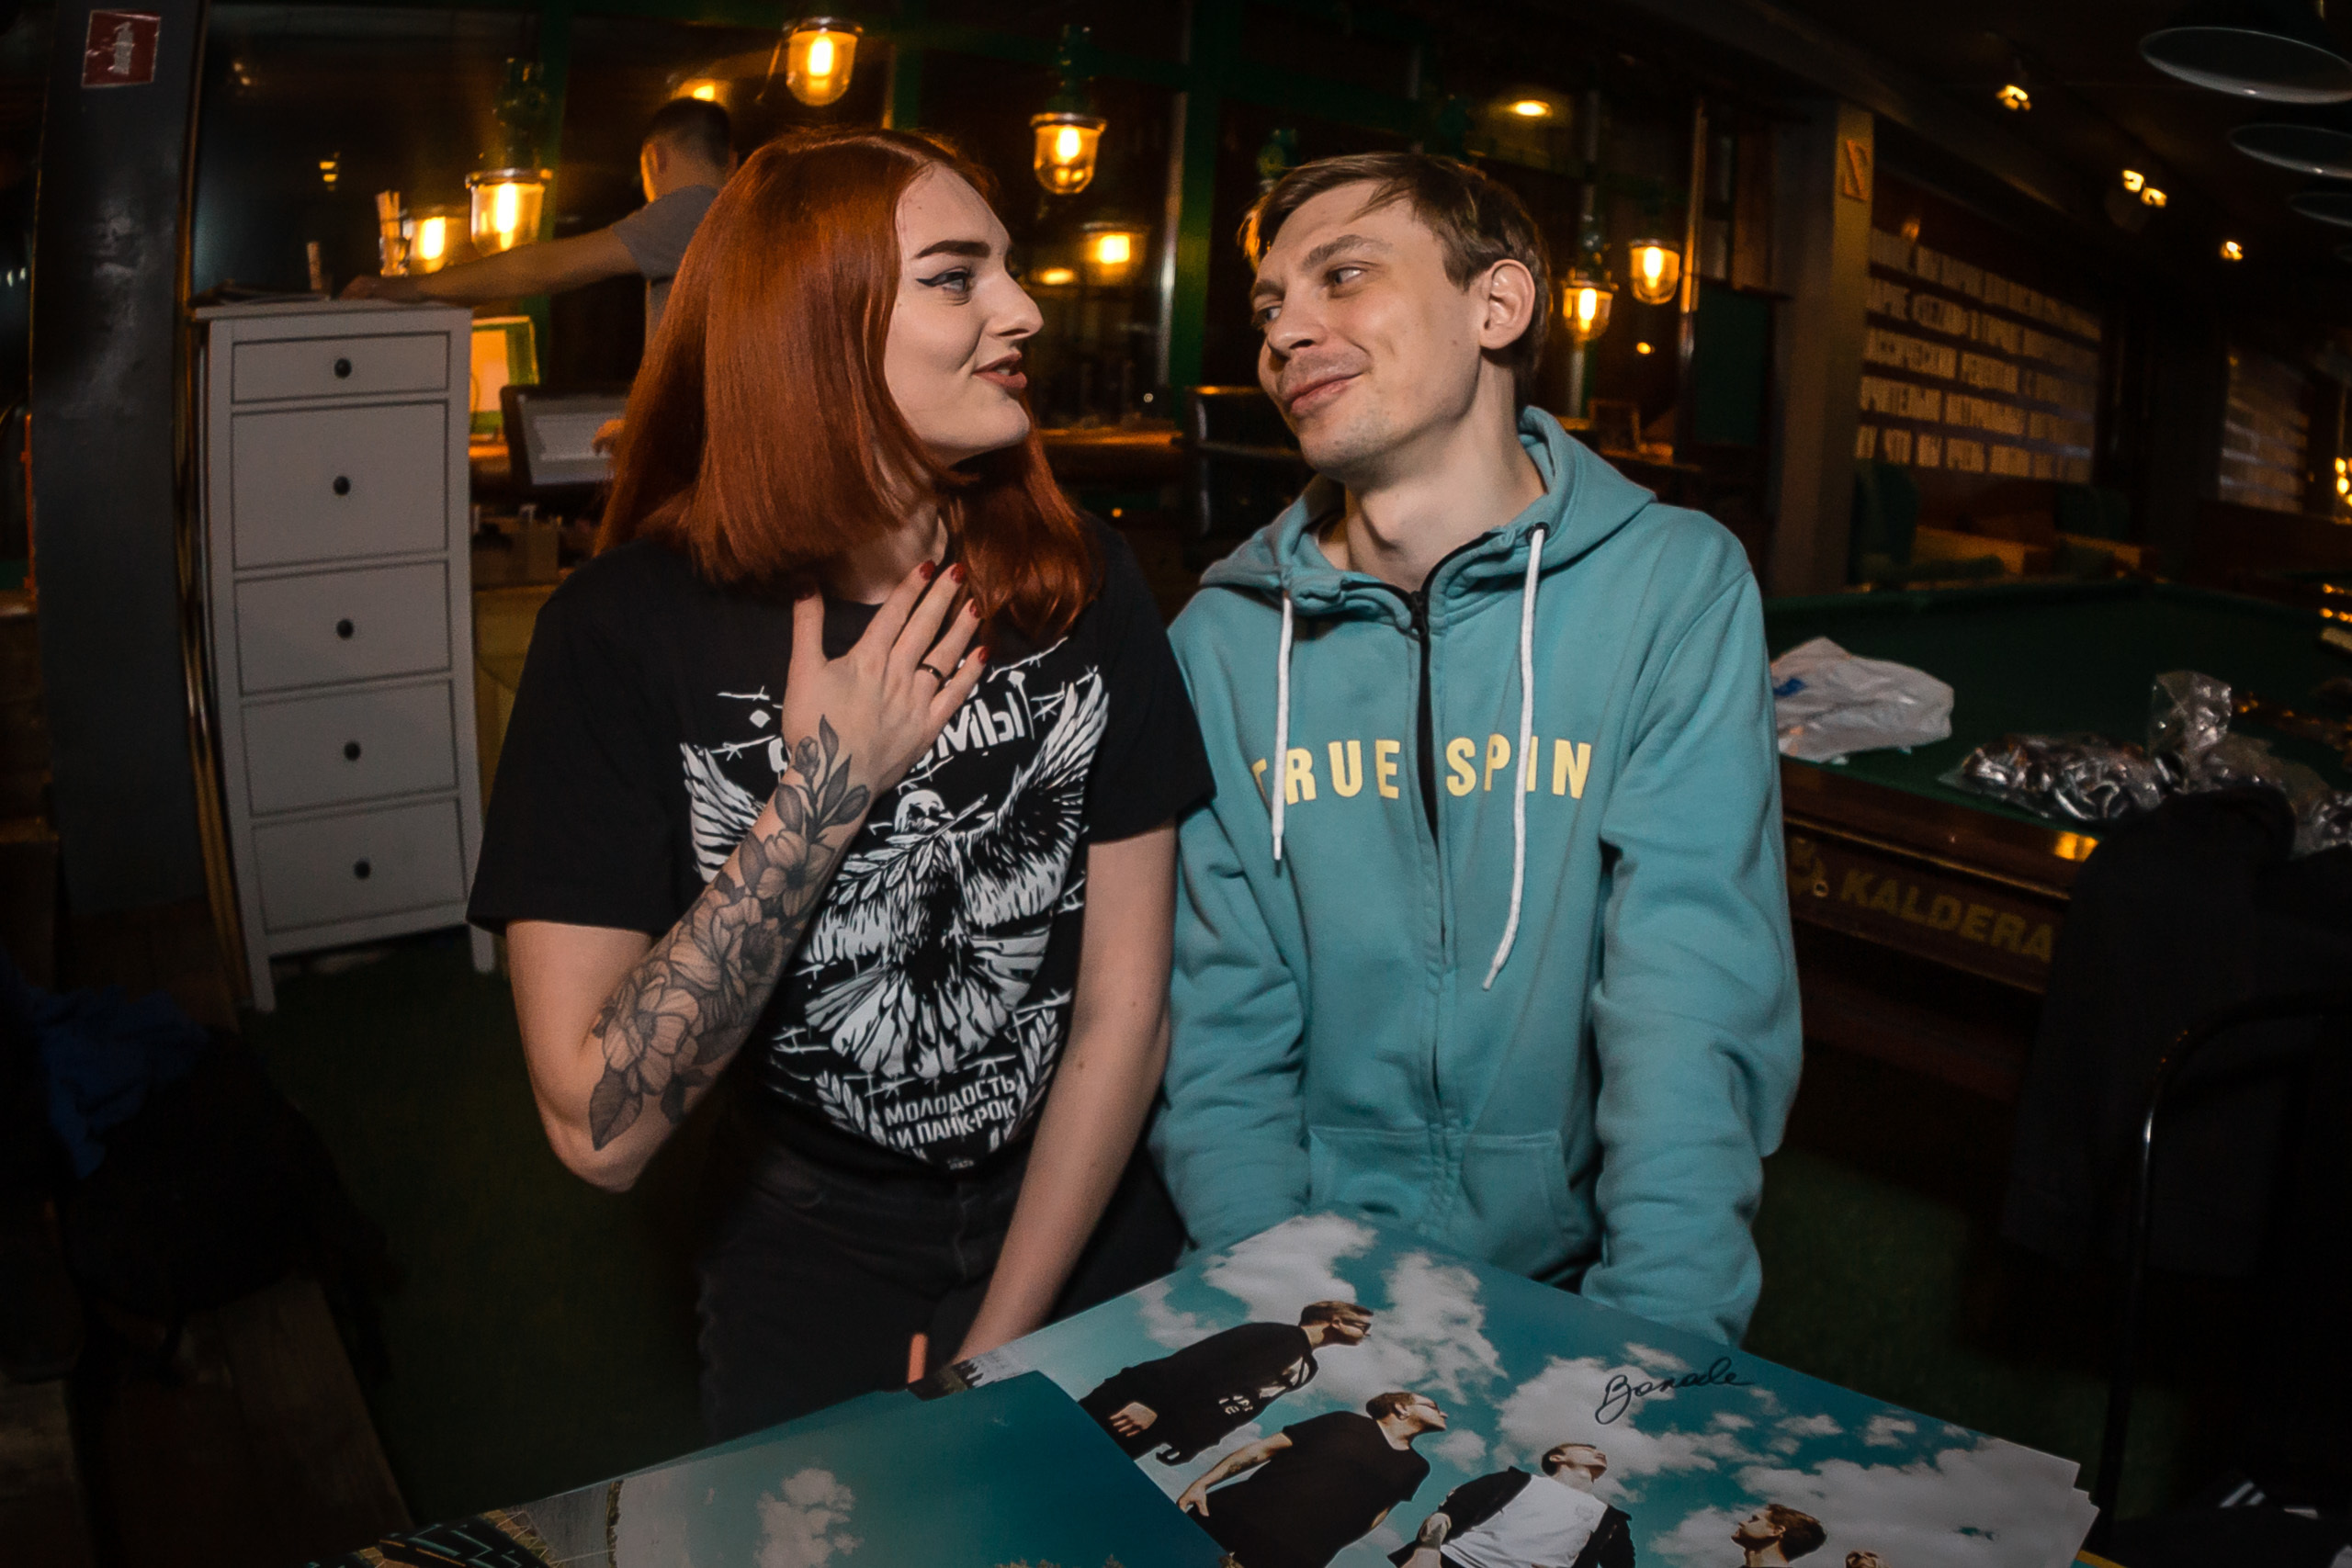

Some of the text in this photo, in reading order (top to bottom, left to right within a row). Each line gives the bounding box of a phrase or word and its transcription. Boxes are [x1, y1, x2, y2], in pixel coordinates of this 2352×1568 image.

[1445, 733, 1592, 799] SPIN
[1840, 868, 2053, 964] KALDERA
[884, 1075, 1016, 1126] МОЛОДОСТЬ
